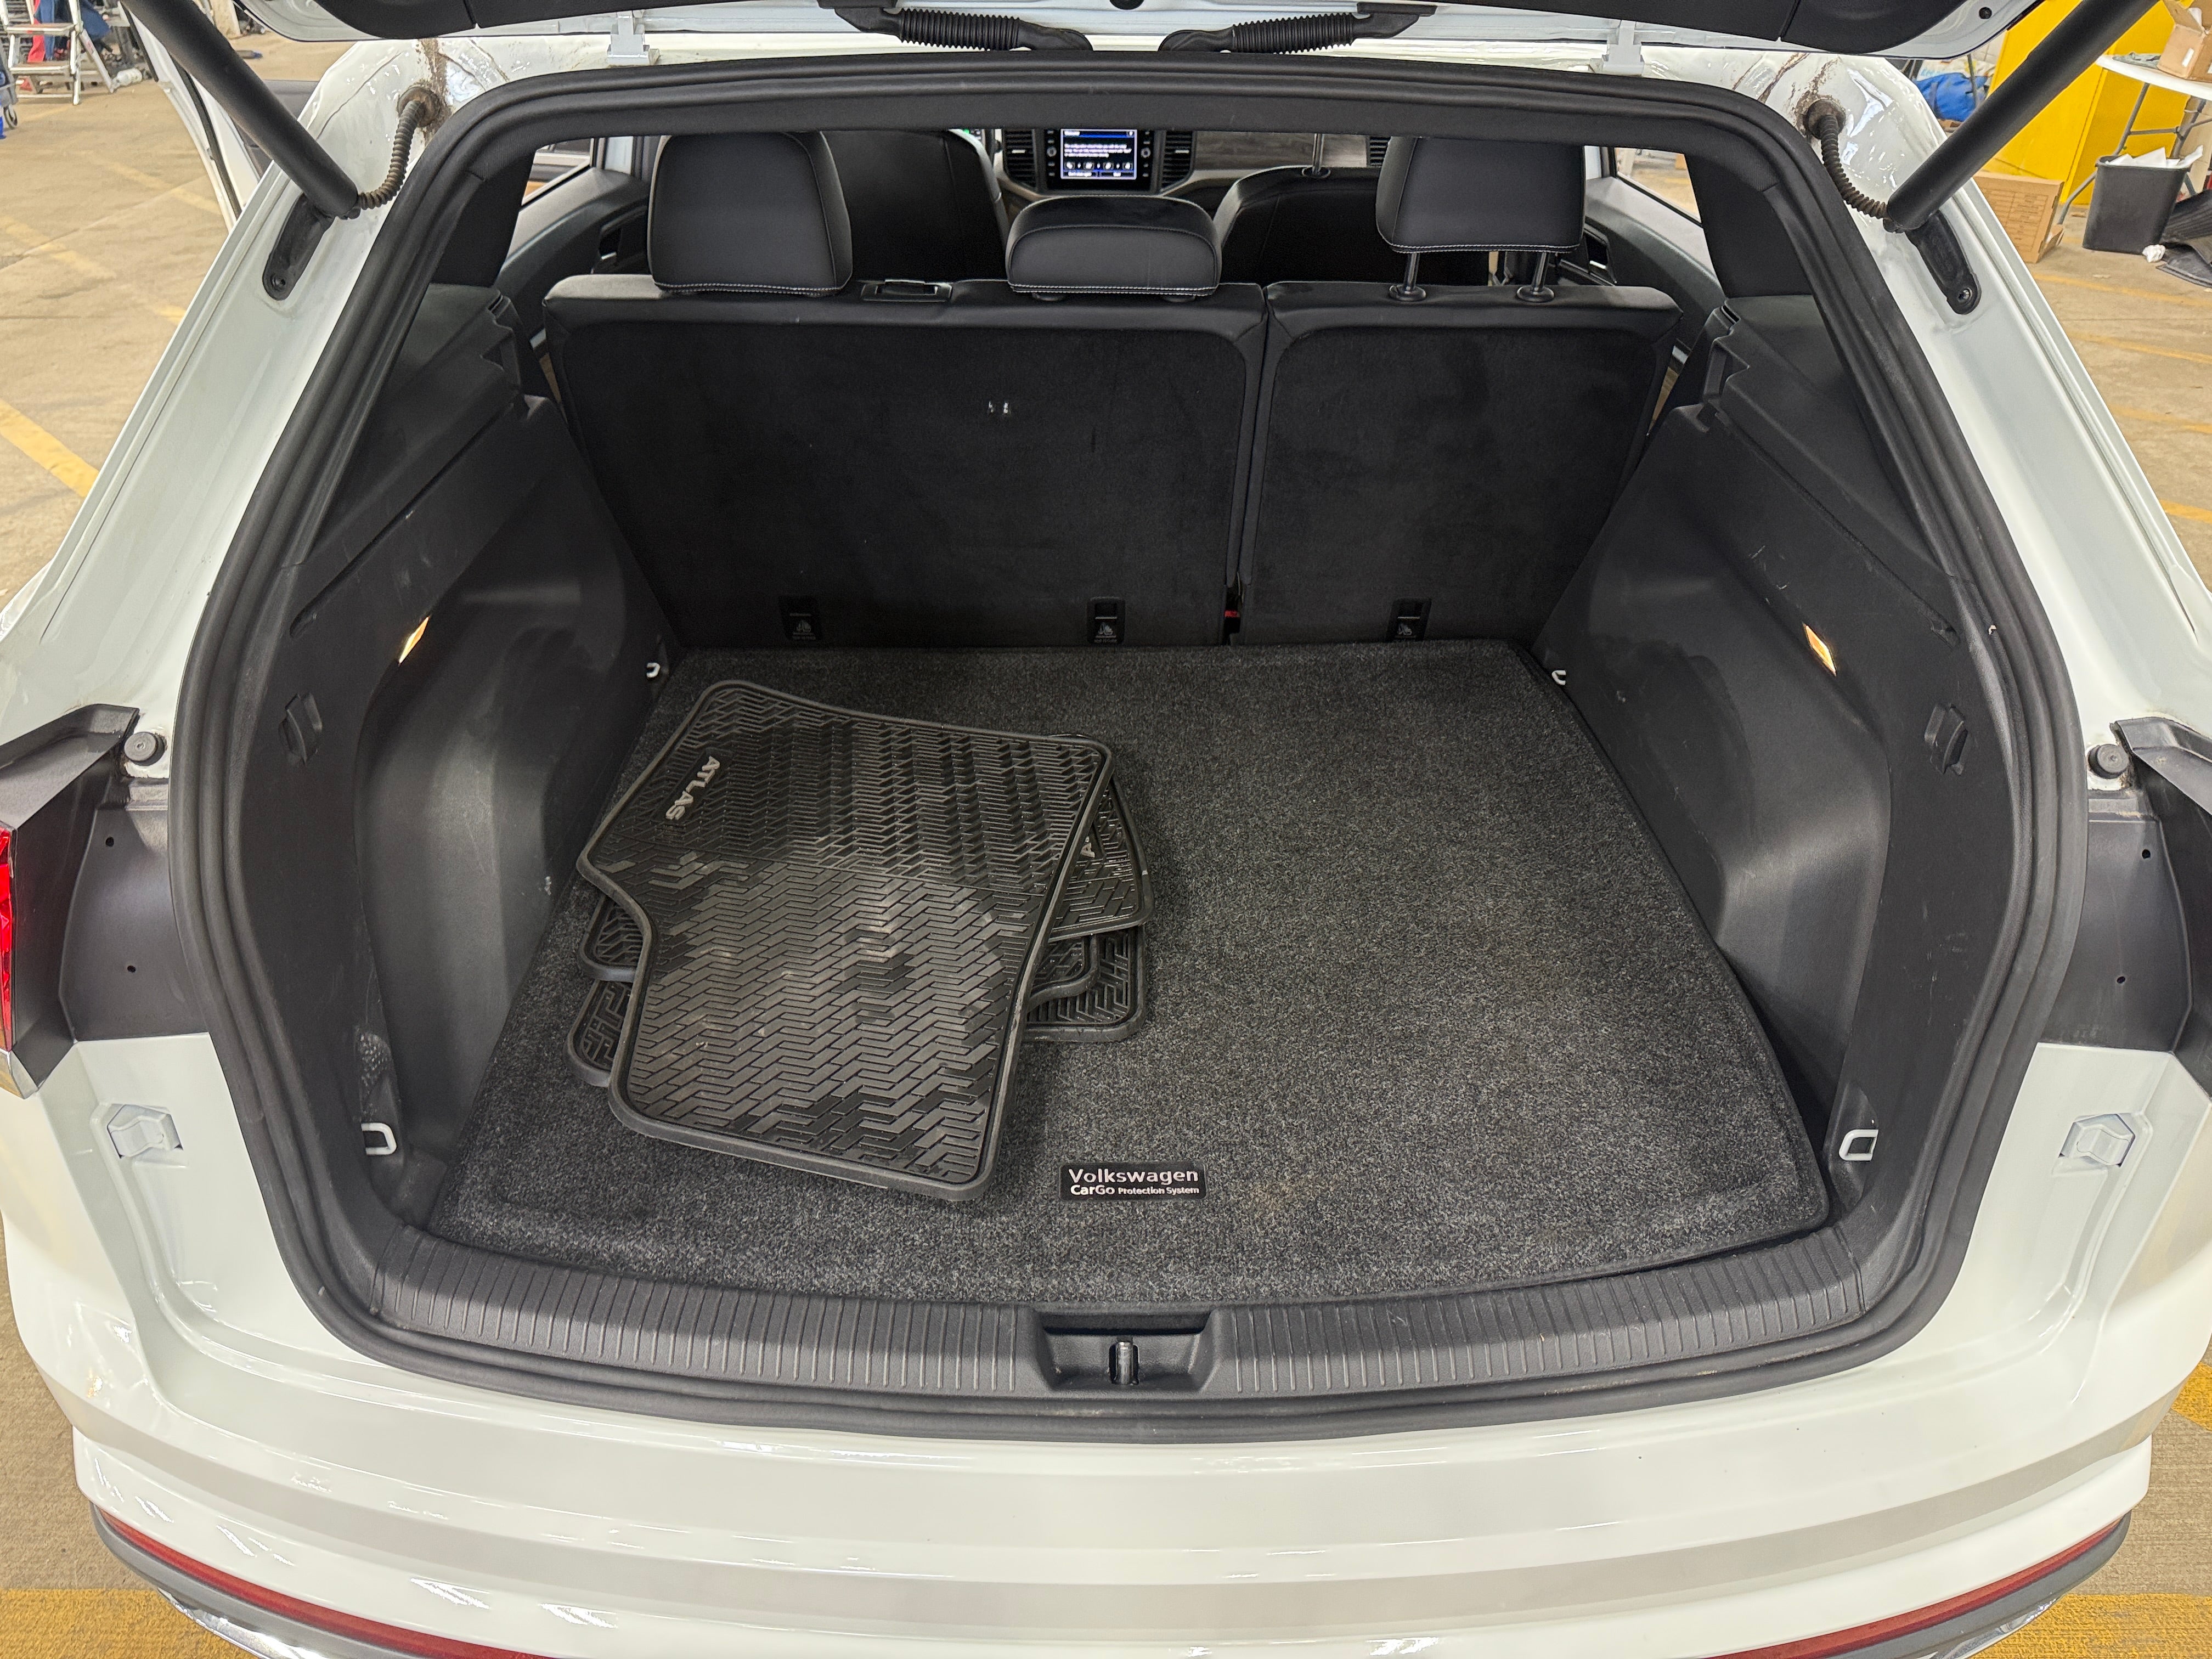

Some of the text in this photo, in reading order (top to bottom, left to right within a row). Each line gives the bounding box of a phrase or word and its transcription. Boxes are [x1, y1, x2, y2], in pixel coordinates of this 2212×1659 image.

[665, 755, 720, 820] ATLAS
[1069, 1169, 1198, 1185] Volkswagen
[1070, 1184, 1199, 1195] CarGo Protection System
